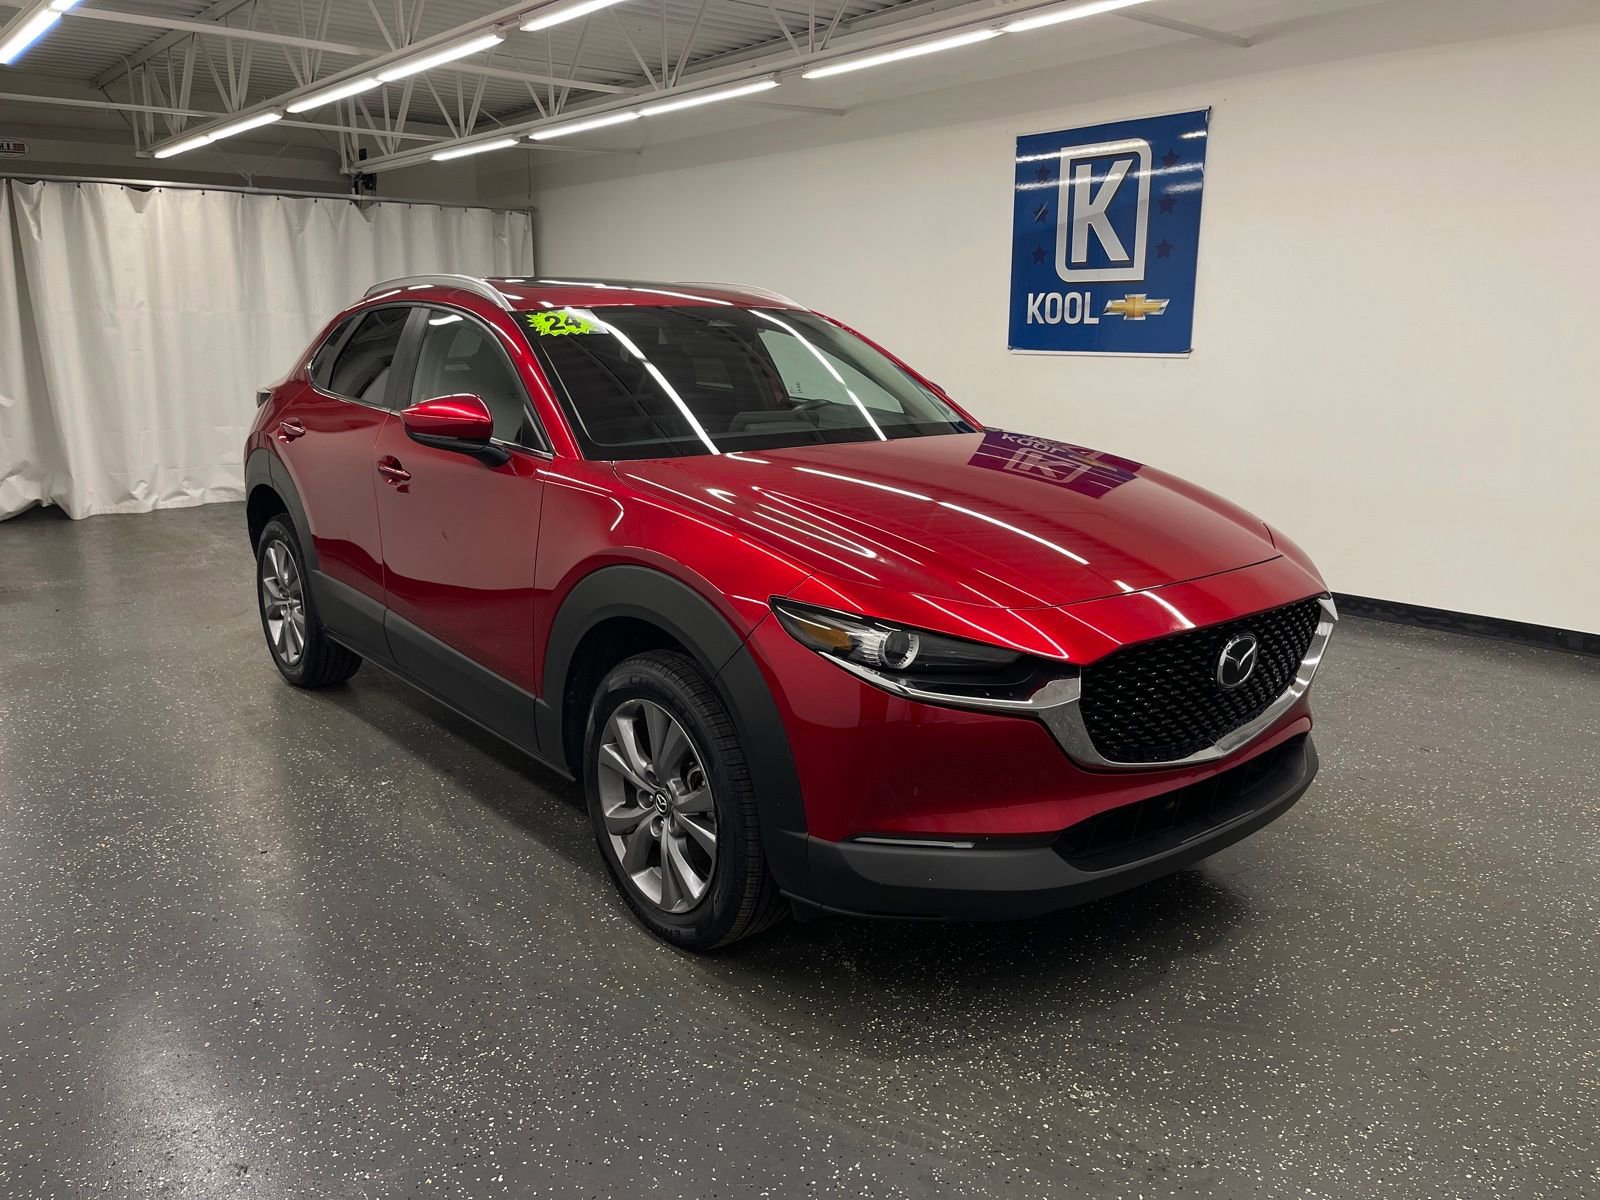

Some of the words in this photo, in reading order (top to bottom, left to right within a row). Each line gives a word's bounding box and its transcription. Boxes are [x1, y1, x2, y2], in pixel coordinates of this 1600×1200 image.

[1071, 159, 1133, 263] K
[544, 315, 582, 331] 24
[1026, 291, 1100, 325] KOOL
